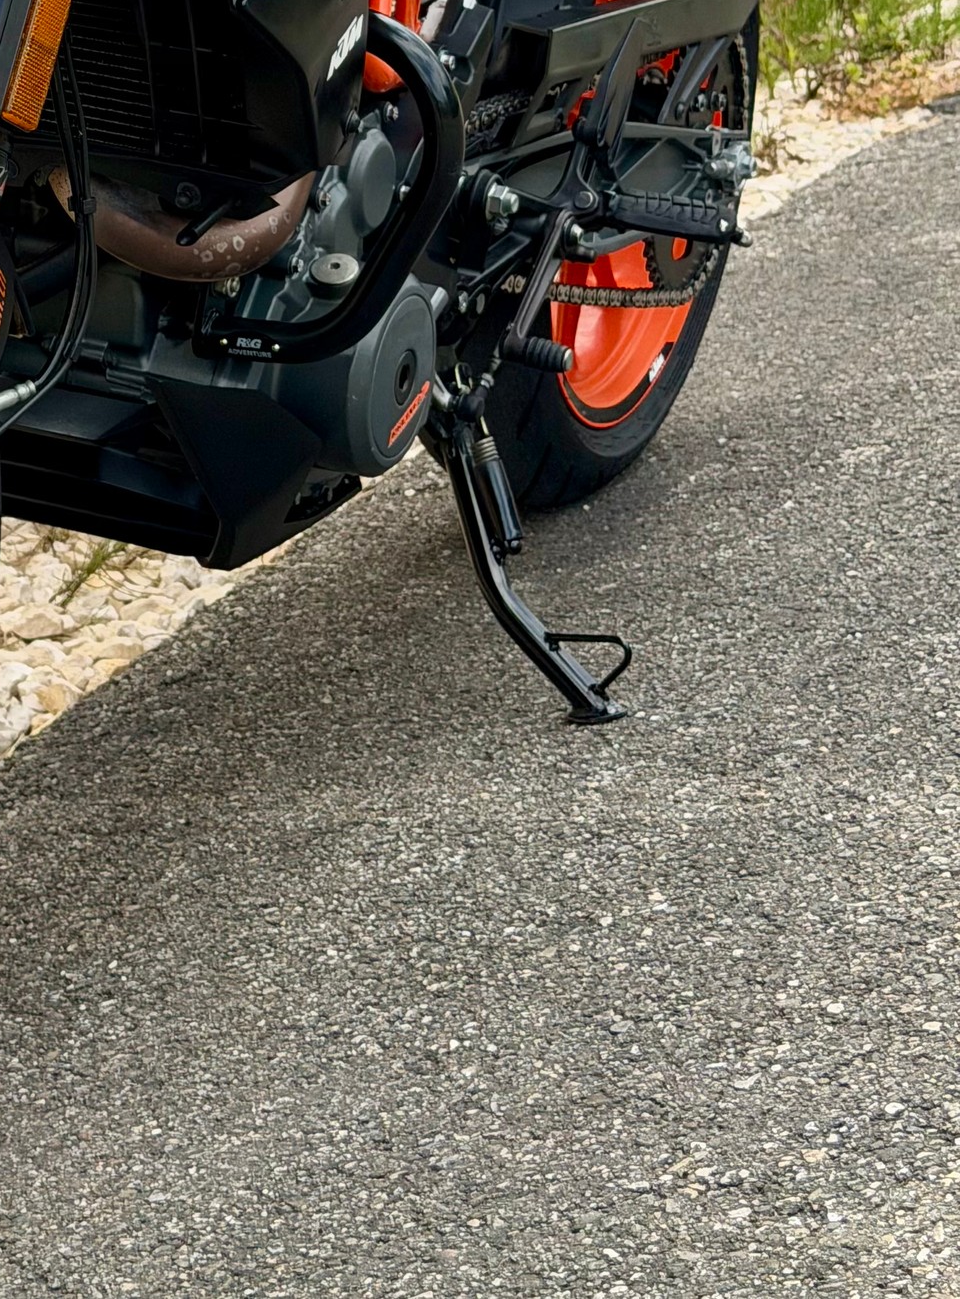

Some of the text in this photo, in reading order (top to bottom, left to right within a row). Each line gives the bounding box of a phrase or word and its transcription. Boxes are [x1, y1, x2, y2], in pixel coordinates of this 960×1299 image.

[326, 14, 364, 81] KTM
[236, 337, 262, 349] R&G
[227, 347, 273, 359] ADVENTURE
